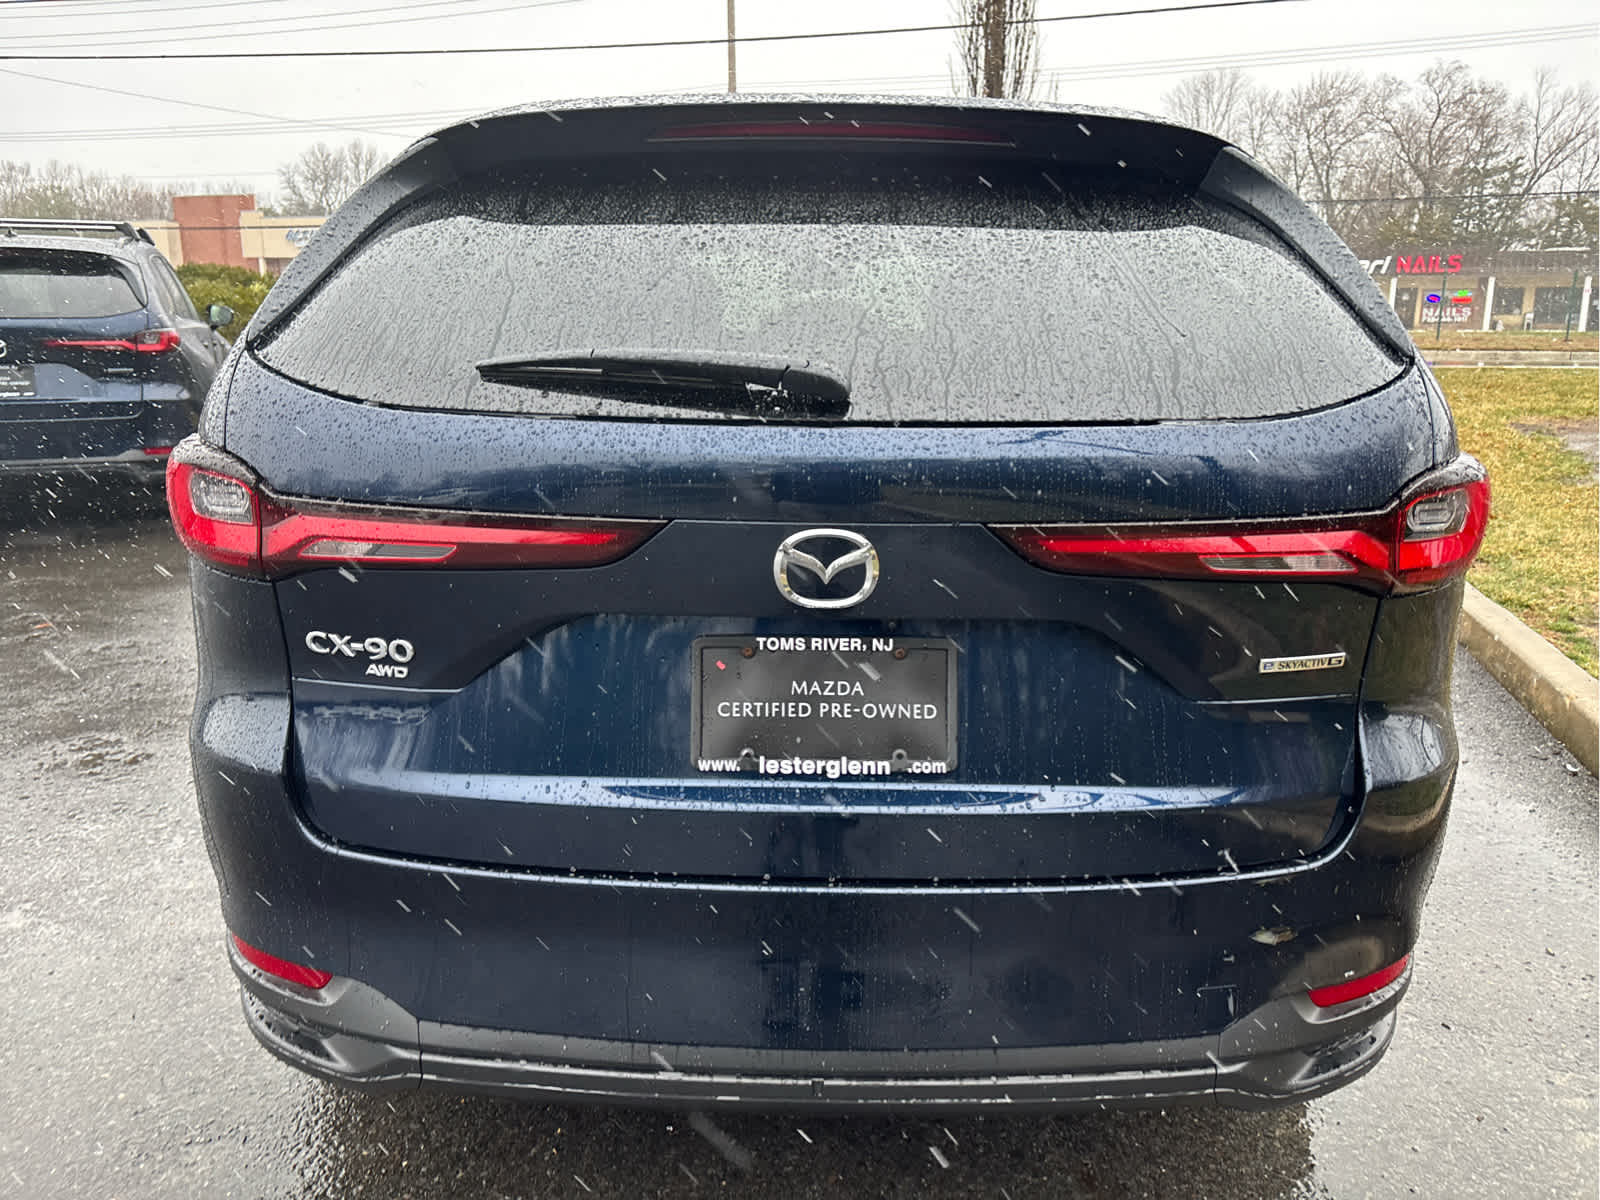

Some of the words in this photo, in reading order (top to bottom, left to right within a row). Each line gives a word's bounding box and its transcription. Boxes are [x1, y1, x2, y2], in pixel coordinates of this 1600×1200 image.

[1396, 254, 1463, 273] NAILS
[305, 630, 414, 663] CX-90
[756, 637, 806, 651] TOMS
[811, 637, 867, 652] RIVER,
[872, 638, 894, 651] NJ
[365, 663, 408, 678] AWD
[791, 681, 864, 696] MAZDA
[717, 702, 812, 718] CERTIFIED
[819, 704, 937, 720] PRE-OWNED
[698, 760, 741, 772] www.
[759, 756, 891, 778] lesterglenn
[908, 761, 947, 774] .com
